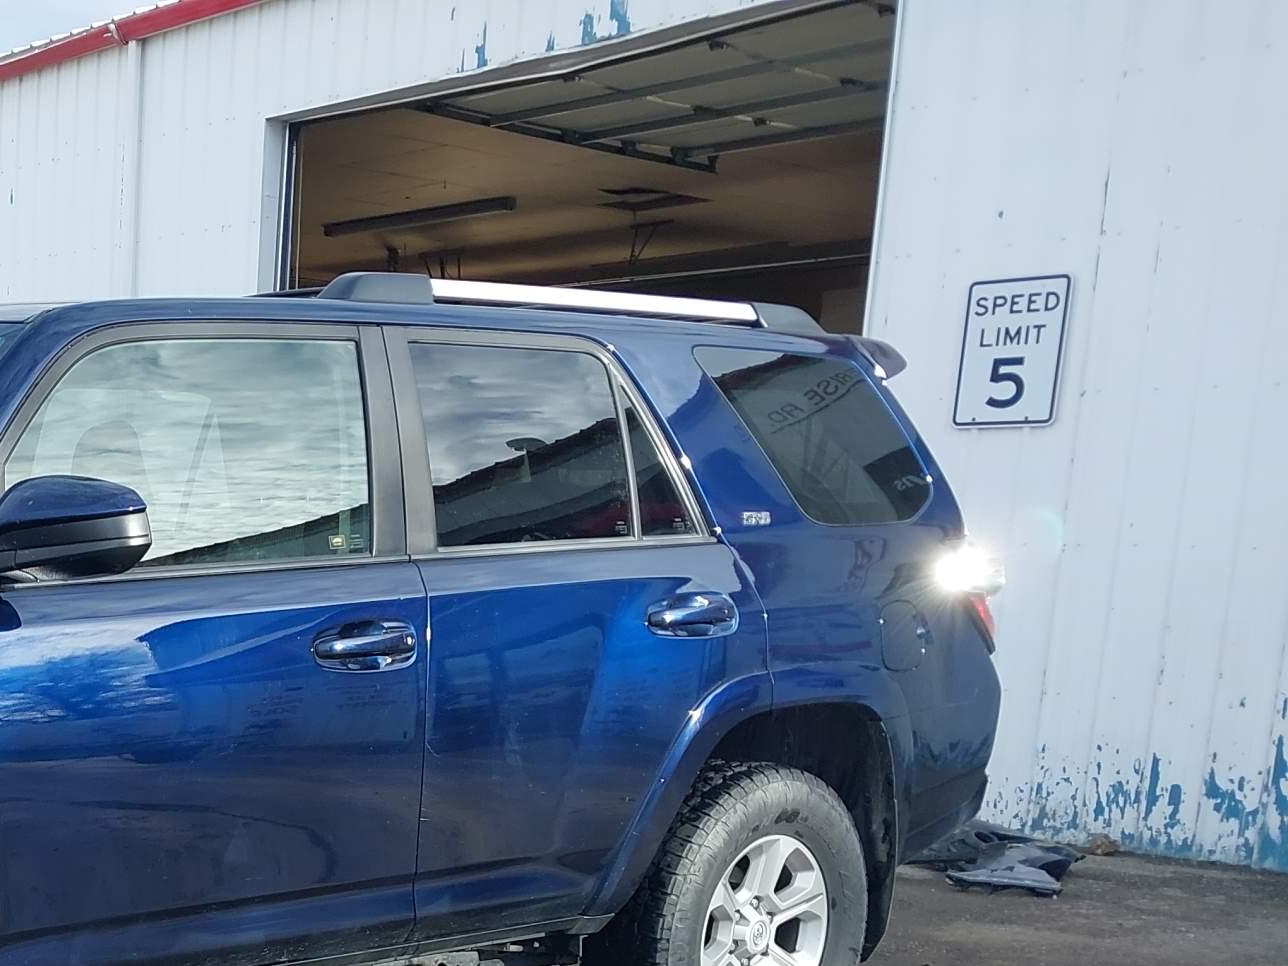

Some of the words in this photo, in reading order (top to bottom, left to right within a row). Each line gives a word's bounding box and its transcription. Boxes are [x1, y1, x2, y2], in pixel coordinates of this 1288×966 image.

[974, 291, 1061, 317] SPEED
[979, 324, 1047, 348] LIMIT
[985, 356, 1026, 409] 5
